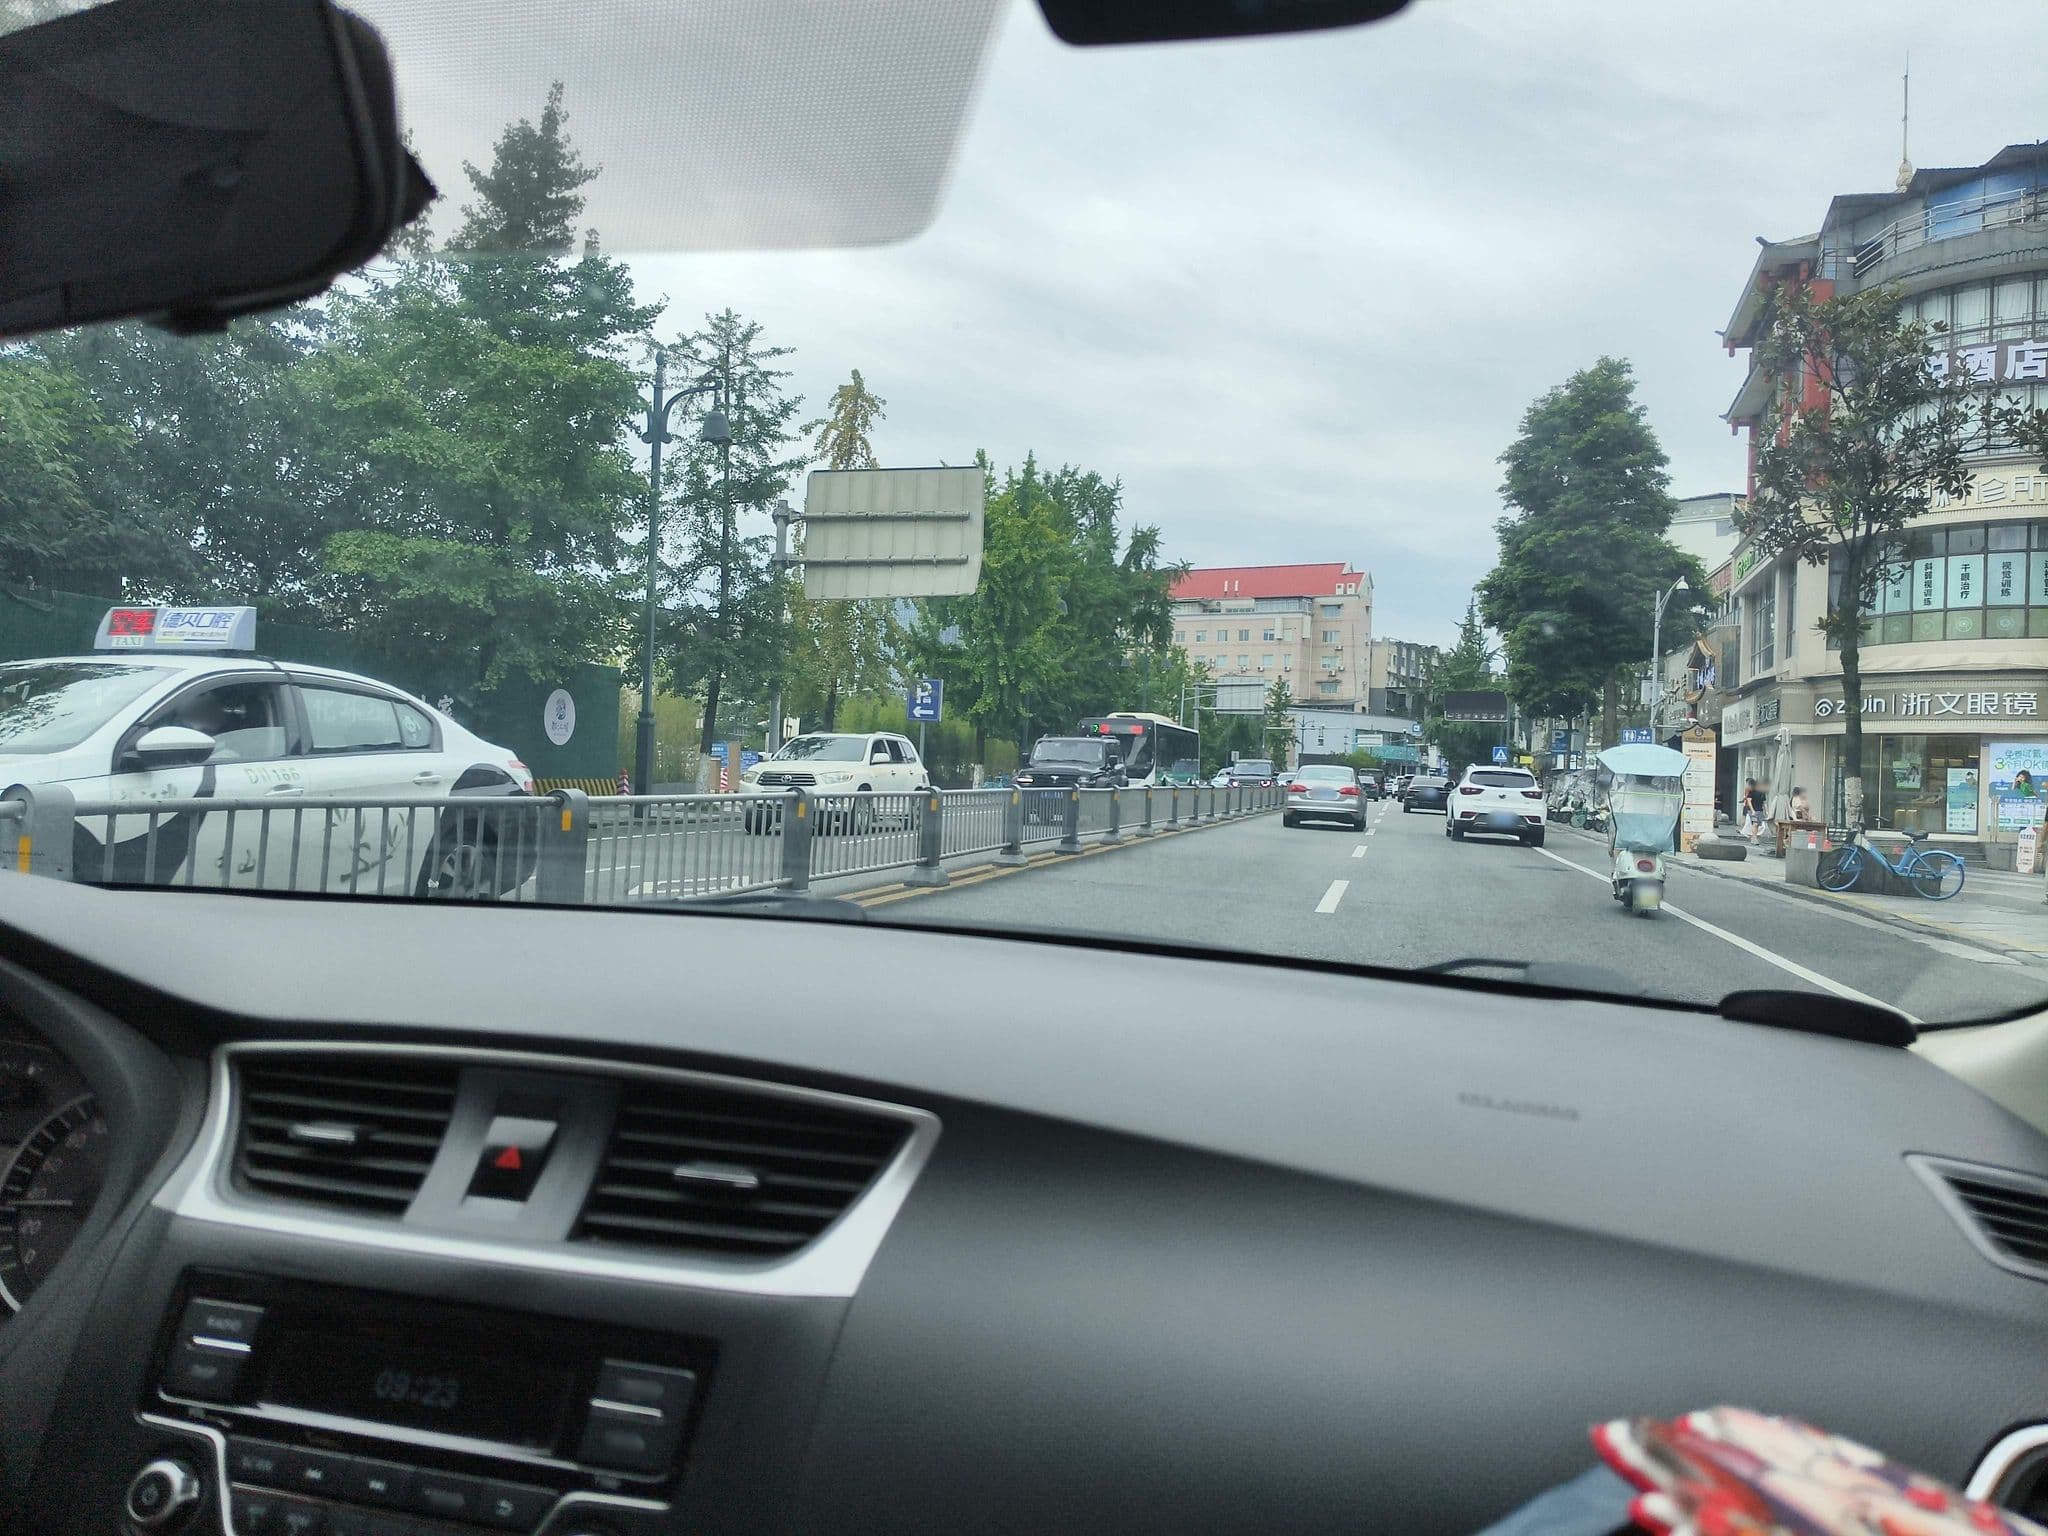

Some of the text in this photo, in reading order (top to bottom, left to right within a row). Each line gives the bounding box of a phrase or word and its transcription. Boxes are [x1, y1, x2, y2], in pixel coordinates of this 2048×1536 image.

[2000, 561, 2012, 597] 视觉训练
[110, 610, 156, 636] 空车
[114, 637, 143, 647] TAXI
[1901, 692, 2038, 716] 浙文眼镜
